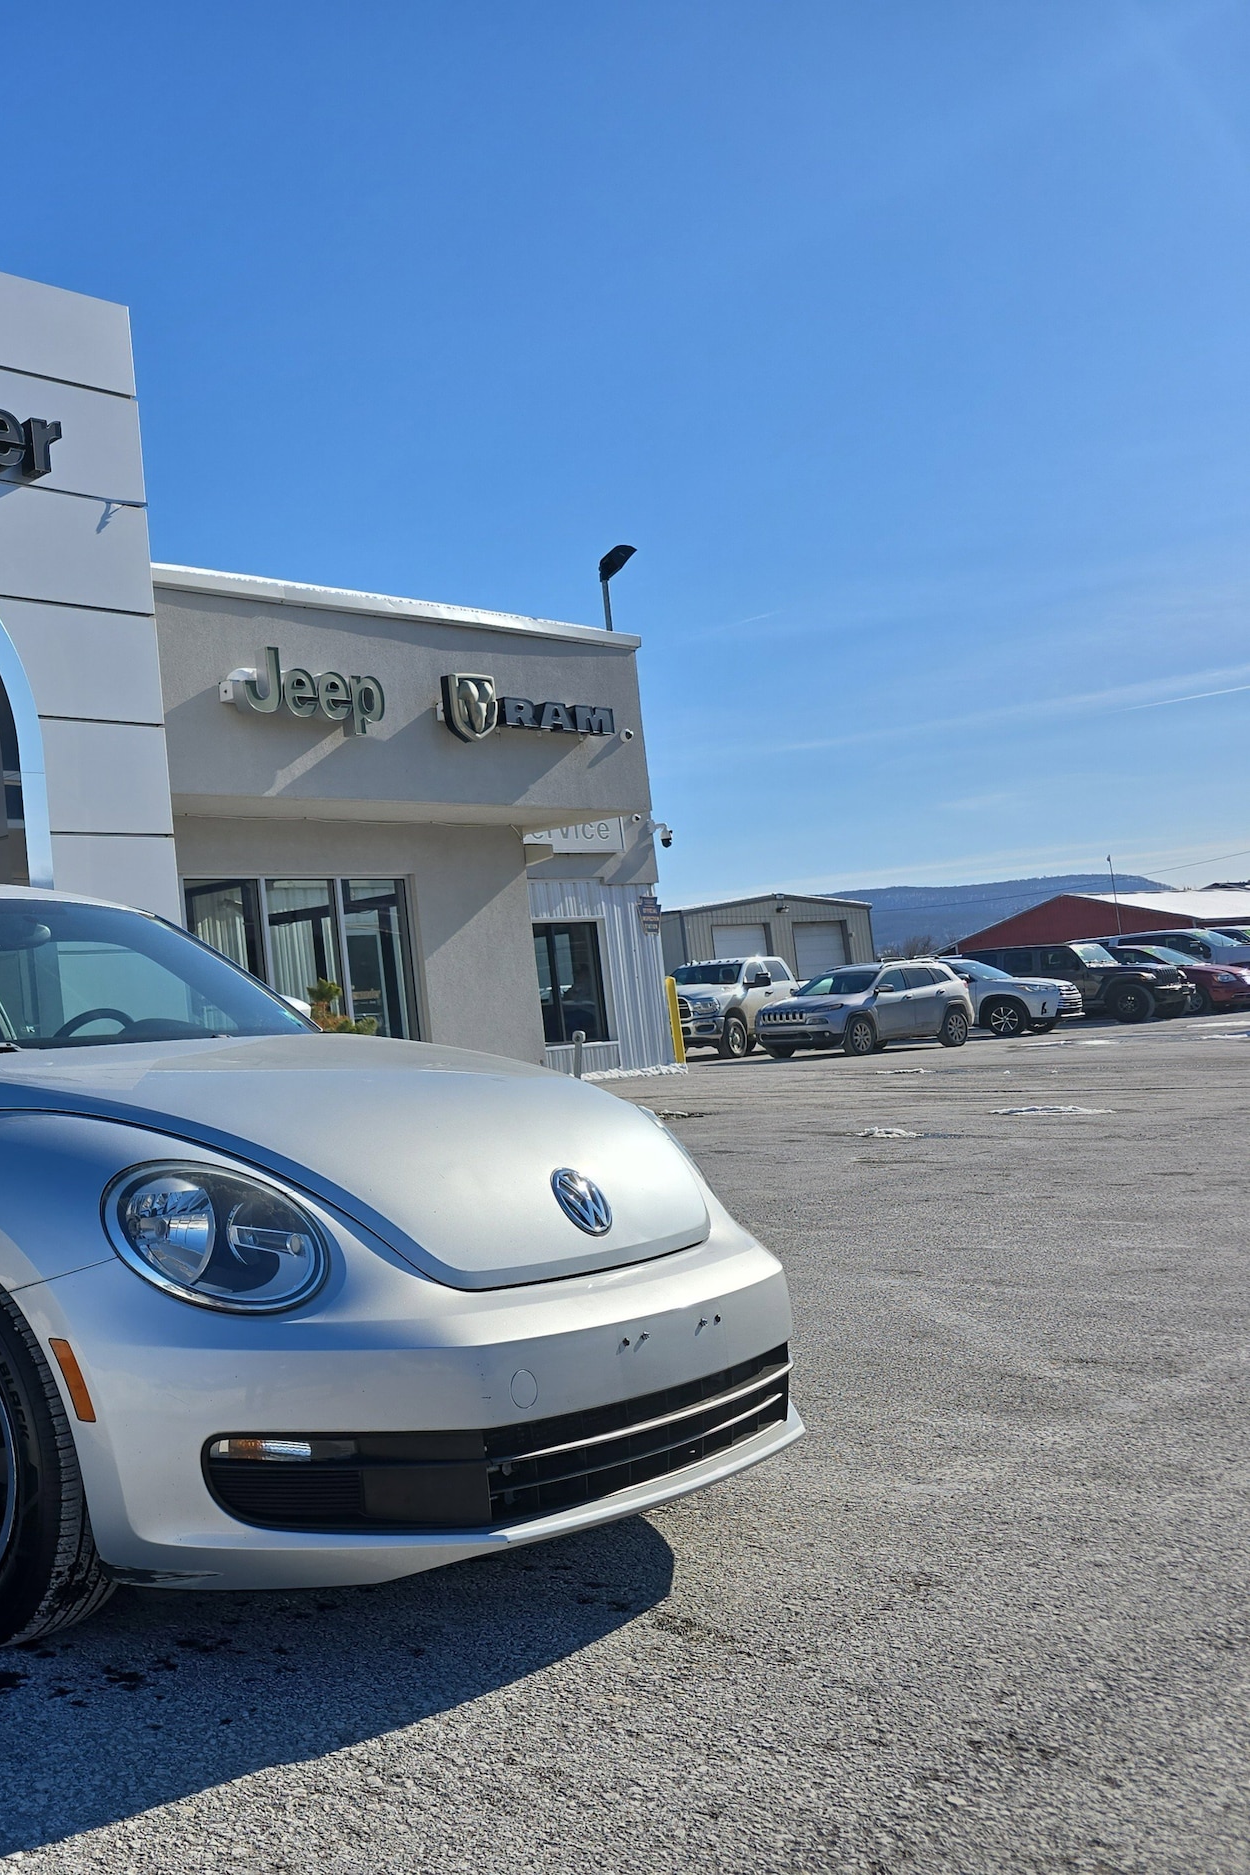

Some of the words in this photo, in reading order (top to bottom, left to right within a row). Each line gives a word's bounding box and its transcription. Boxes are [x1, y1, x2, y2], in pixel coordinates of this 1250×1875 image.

[245, 646, 385, 736] Jeep
[499, 696, 615, 736] RAM
[532, 822, 610, 840] vice
